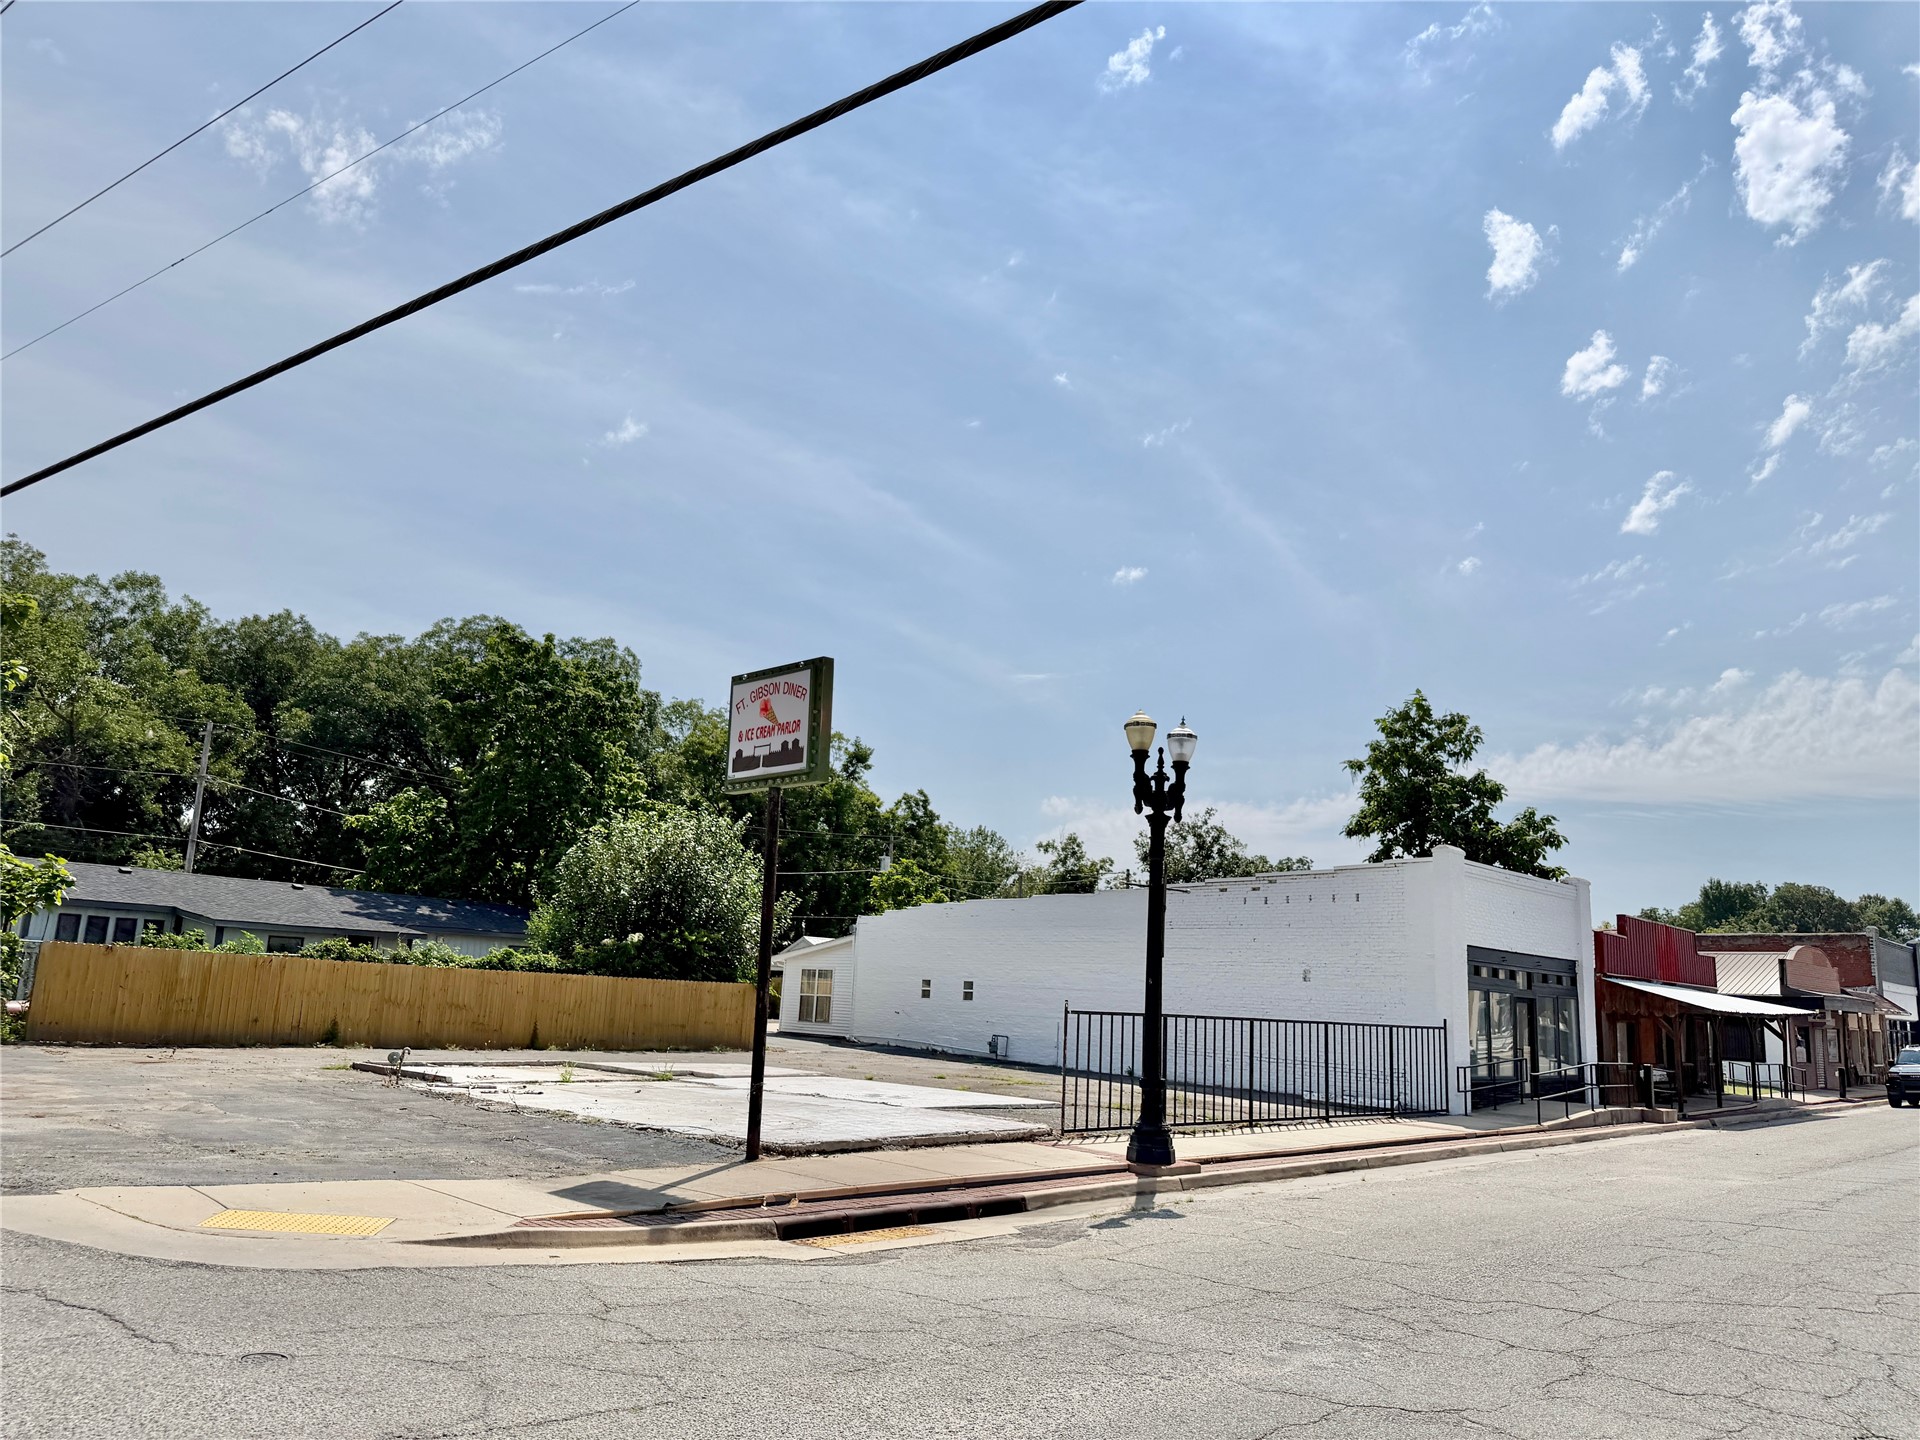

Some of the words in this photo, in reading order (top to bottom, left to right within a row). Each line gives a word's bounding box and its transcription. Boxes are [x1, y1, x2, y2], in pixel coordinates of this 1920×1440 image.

[736, 698, 748, 714] FT.
[750, 682, 780, 703] GIBSON
[783, 682, 807, 701] DINER
[738, 731, 743, 742] &
[745, 728, 754, 741] ICE
[756, 725, 775, 739] CREAM
[777, 719, 801, 736] PARLOR
